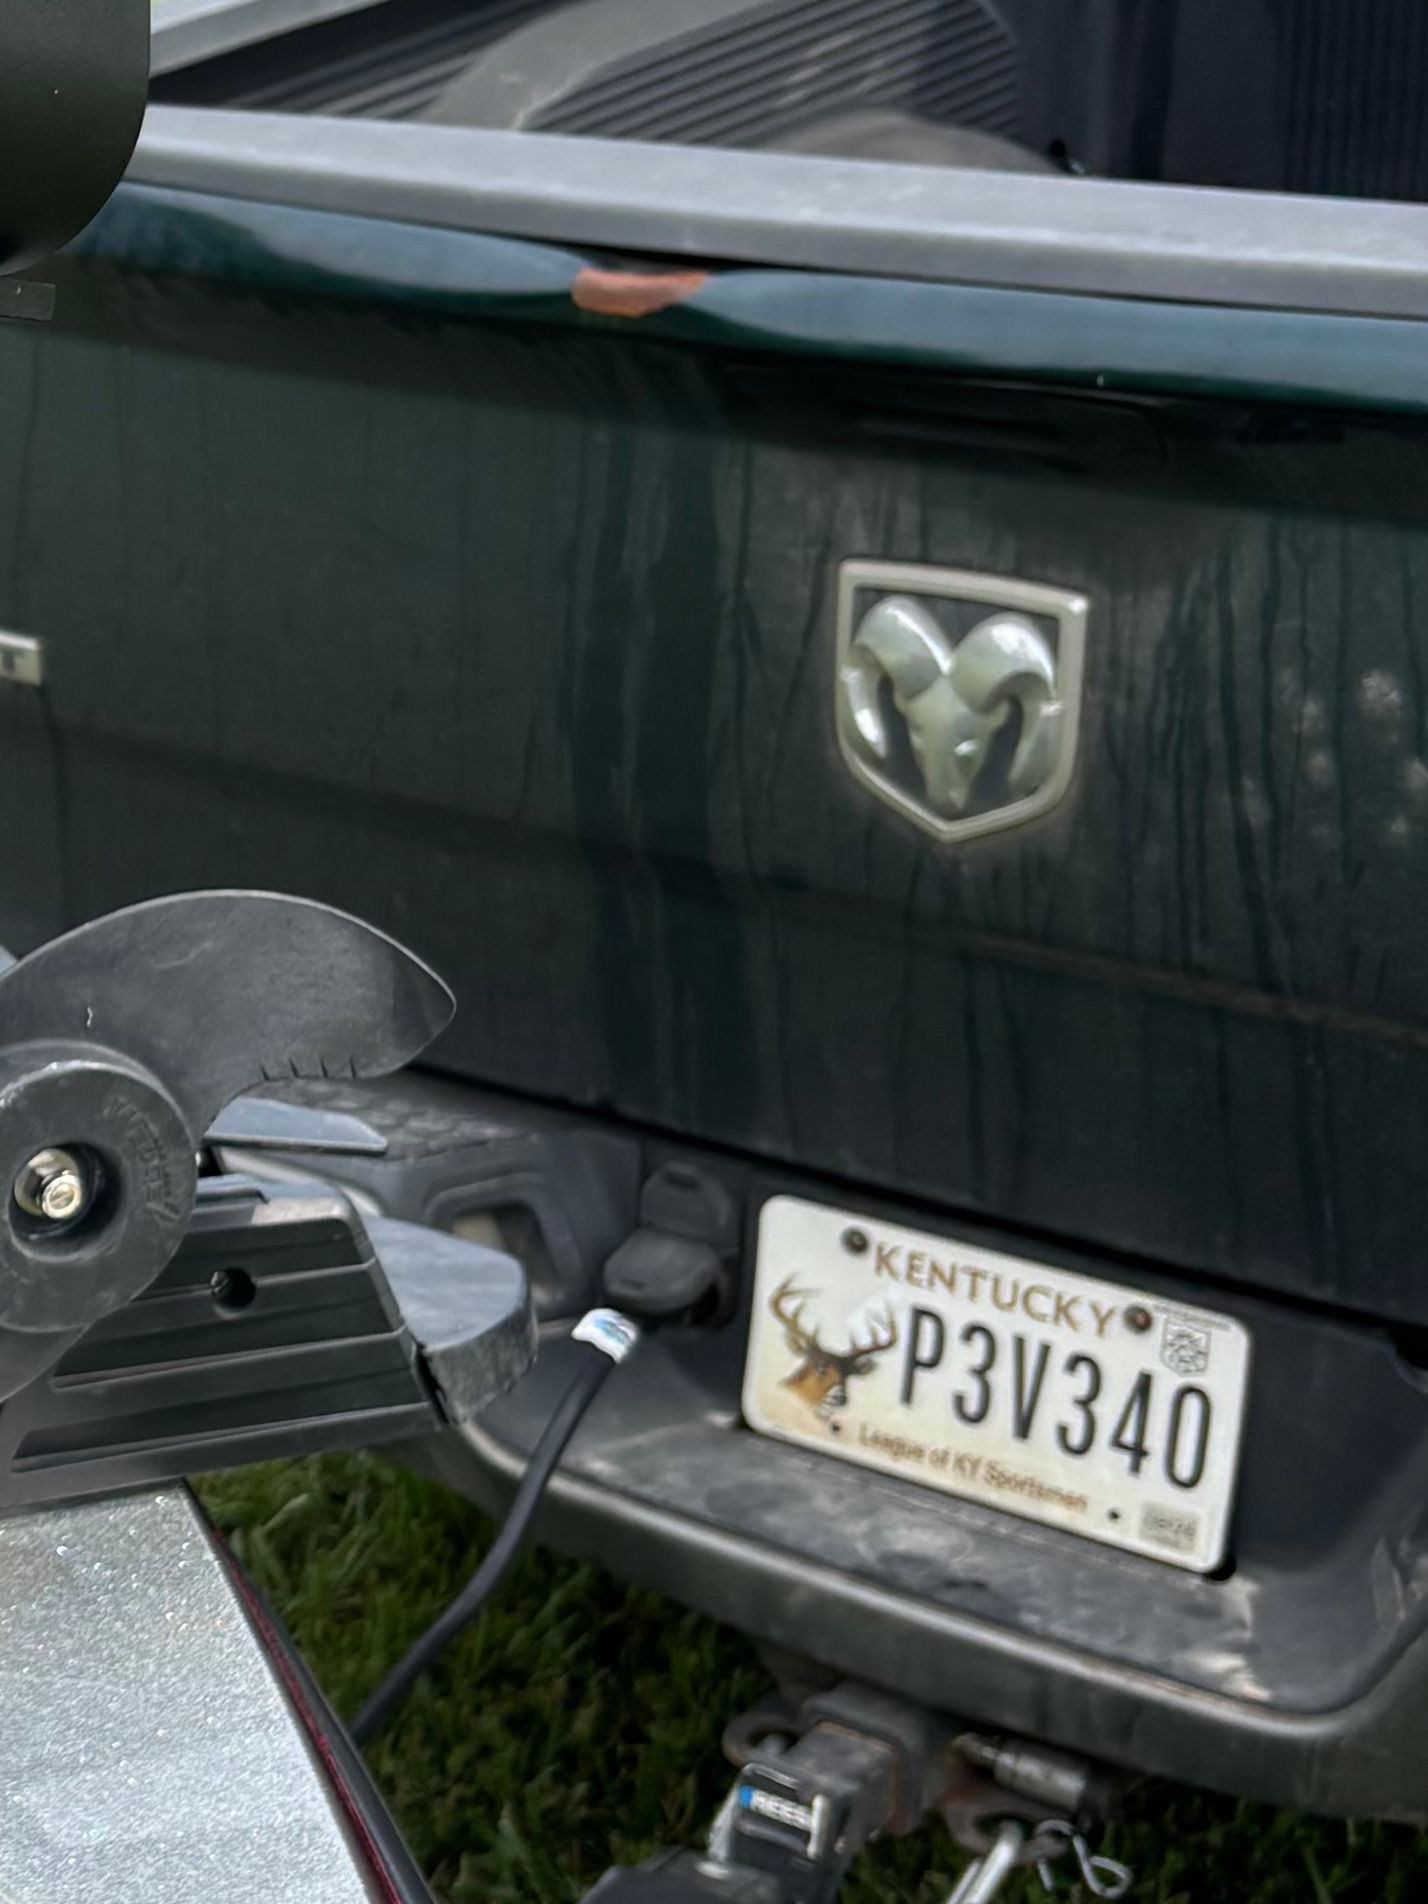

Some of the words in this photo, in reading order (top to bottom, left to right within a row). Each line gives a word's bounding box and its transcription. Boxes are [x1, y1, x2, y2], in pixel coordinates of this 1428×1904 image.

[874, 1242, 1118, 1338] KENTUCKY
[899, 1305, 1213, 1490] P3V340
[858, 1423, 927, 1463] League
[929, 1447, 950, 1469] of
[952, 1450, 981, 1479] KY
